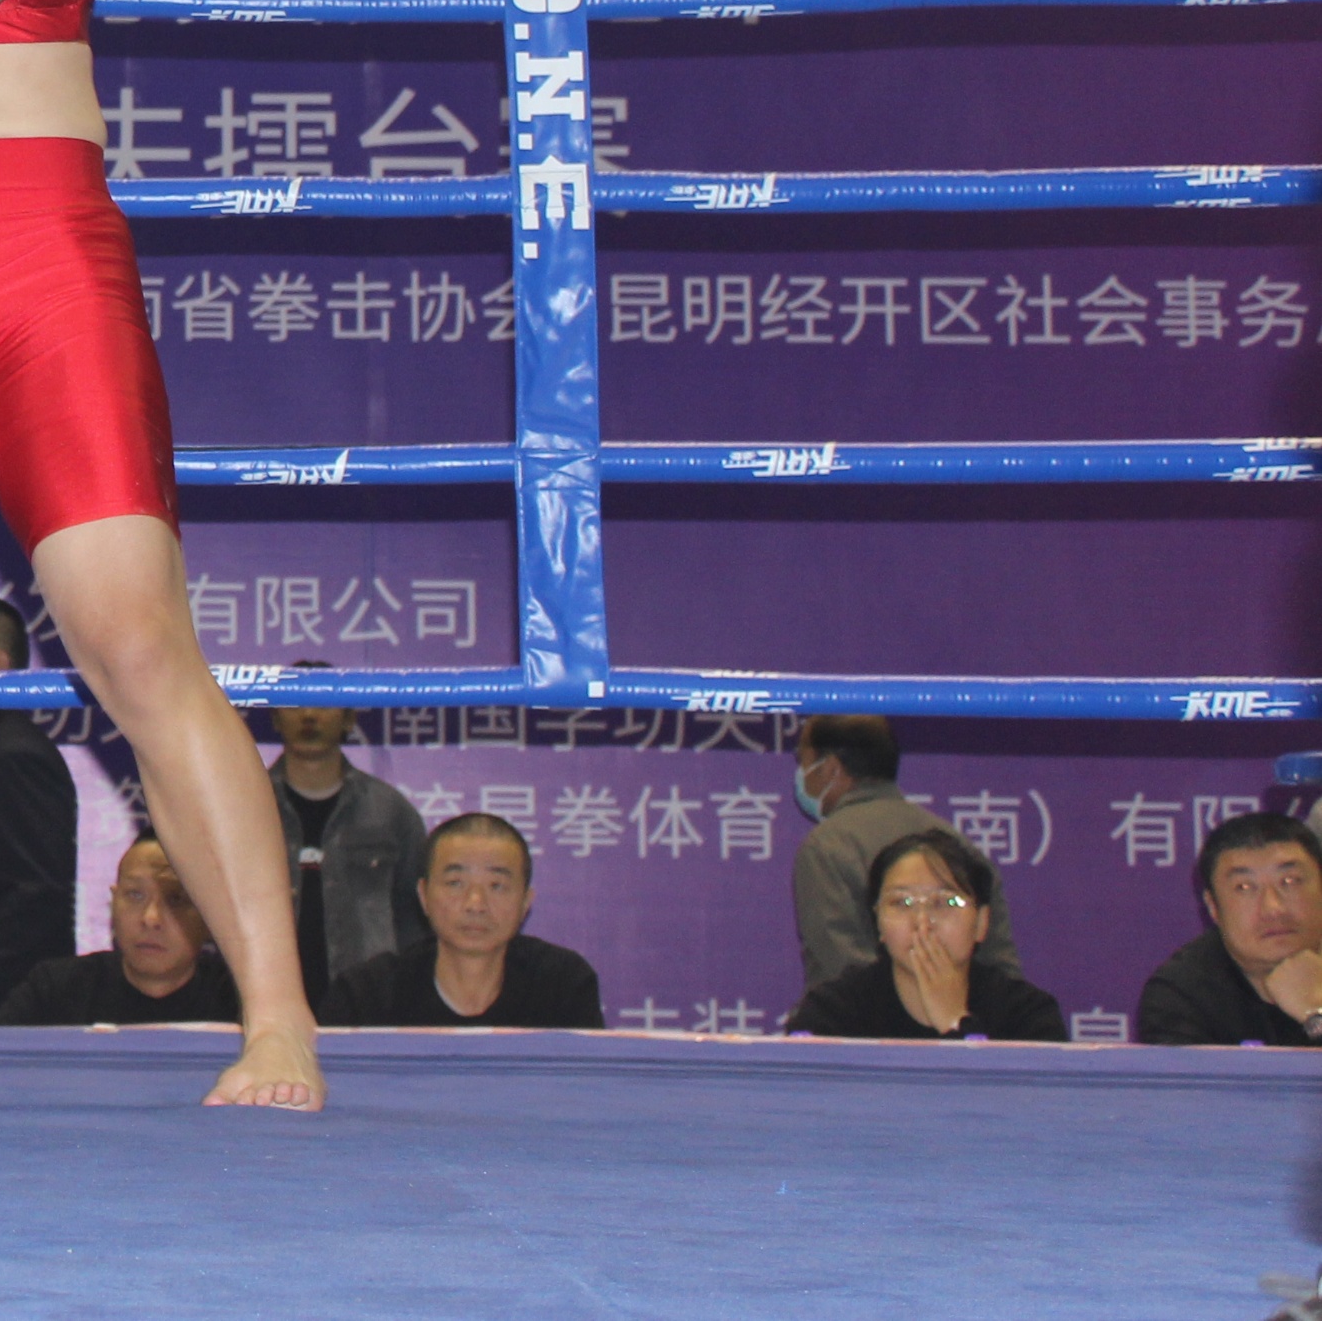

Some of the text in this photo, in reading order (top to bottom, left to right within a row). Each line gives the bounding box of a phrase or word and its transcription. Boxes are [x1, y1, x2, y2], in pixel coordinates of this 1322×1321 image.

[608, 272, 1322, 348] 昆明经开区社会事务
